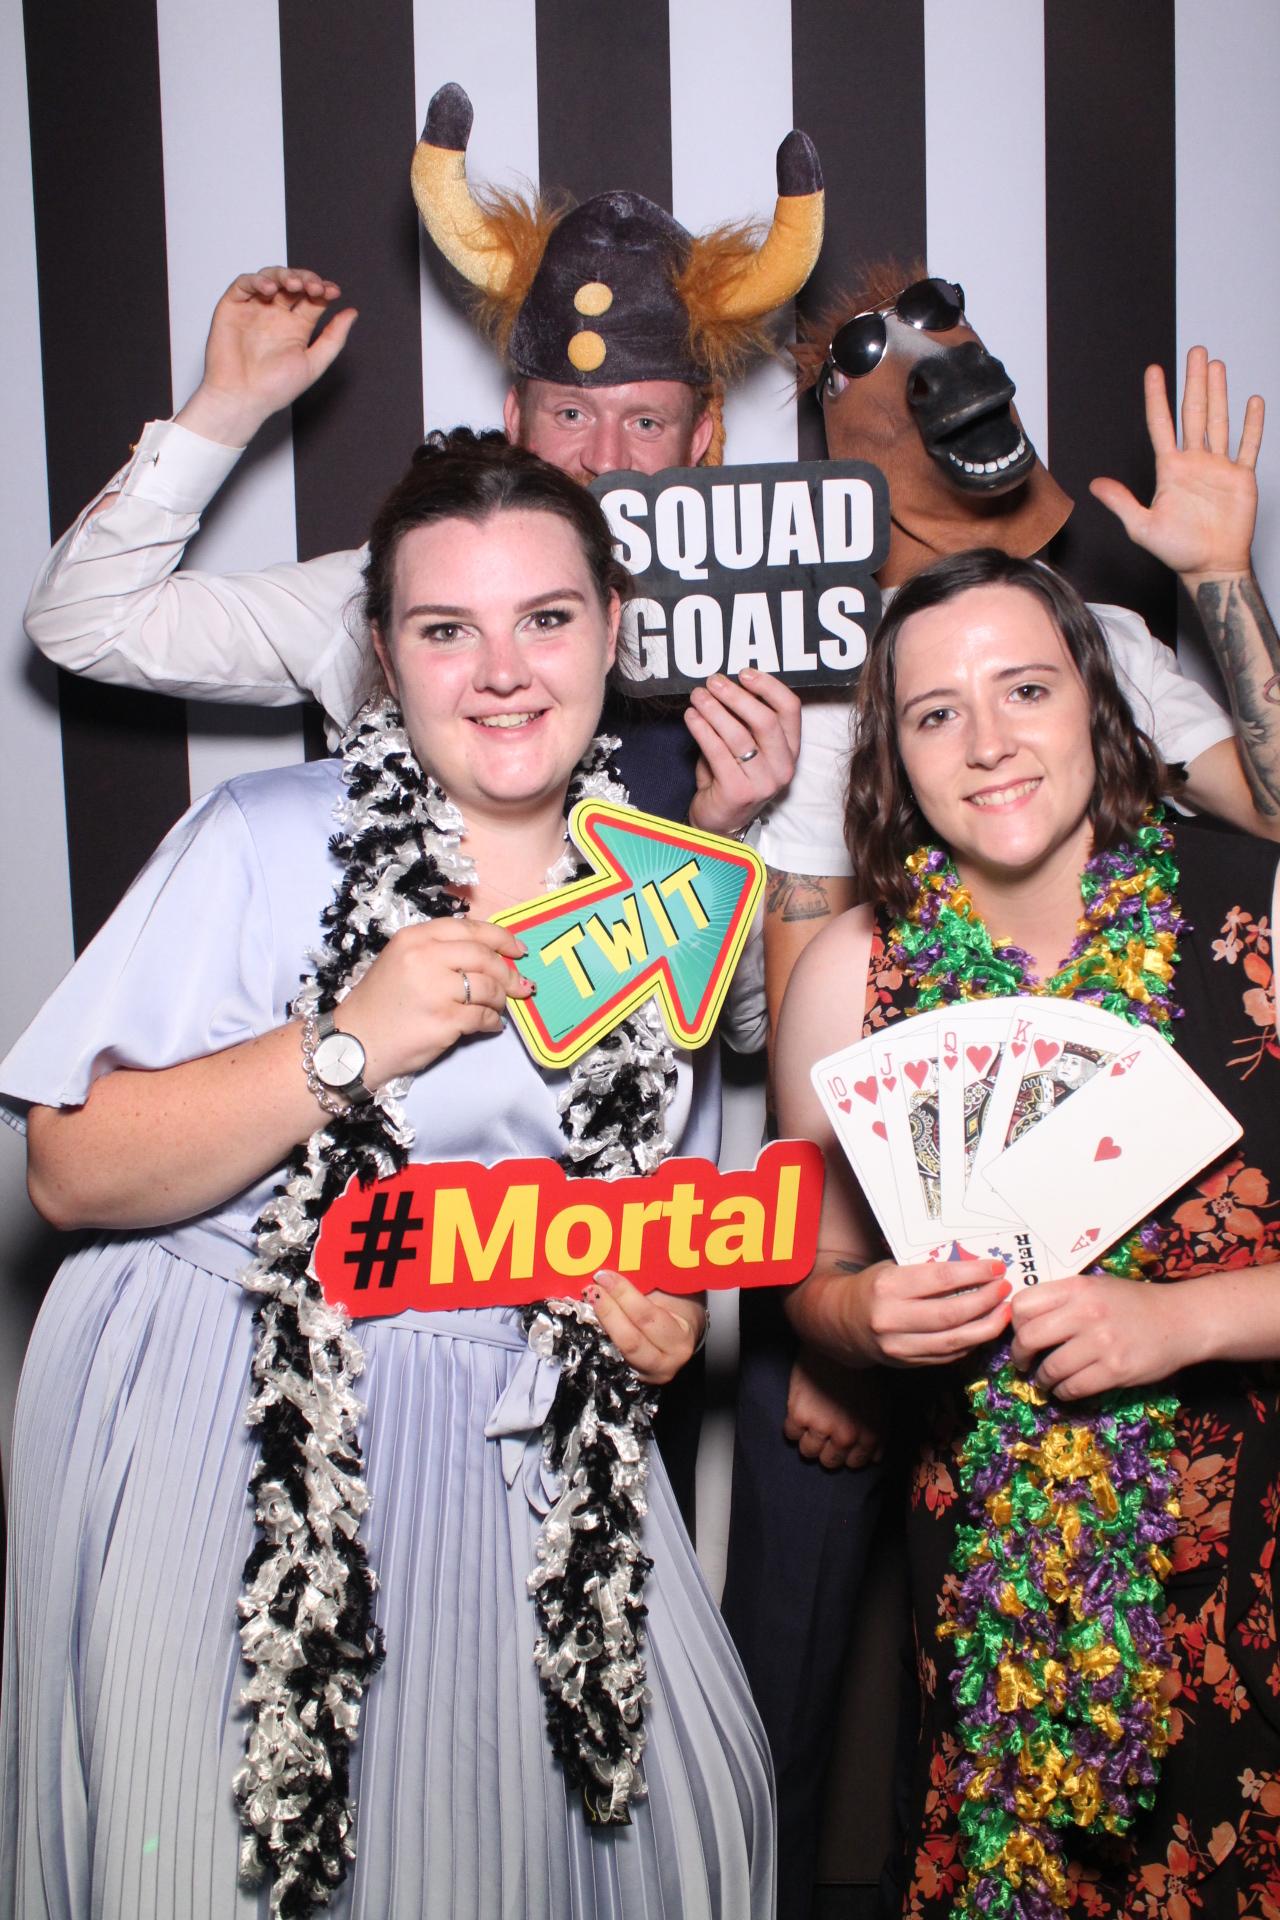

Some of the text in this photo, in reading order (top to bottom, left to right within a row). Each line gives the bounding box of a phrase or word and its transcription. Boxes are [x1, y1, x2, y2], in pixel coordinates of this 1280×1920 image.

[600, 478, 874, 580] SQUAD
[618, 586, 868, 682] GOALS
[539, 858, 711, 999] TWIT
[1014, 1019, 1032, 1041] K
[944, 1031, 957, 1053] Q
[880, 1053, 893, 1075] J
[1121, 1050, 1142, 1069] A
[828, 1076, 847, 1100] 10
[344, 1165, 801, 1290] #Mortal
[1071, 1235, 1090, 1253] A
